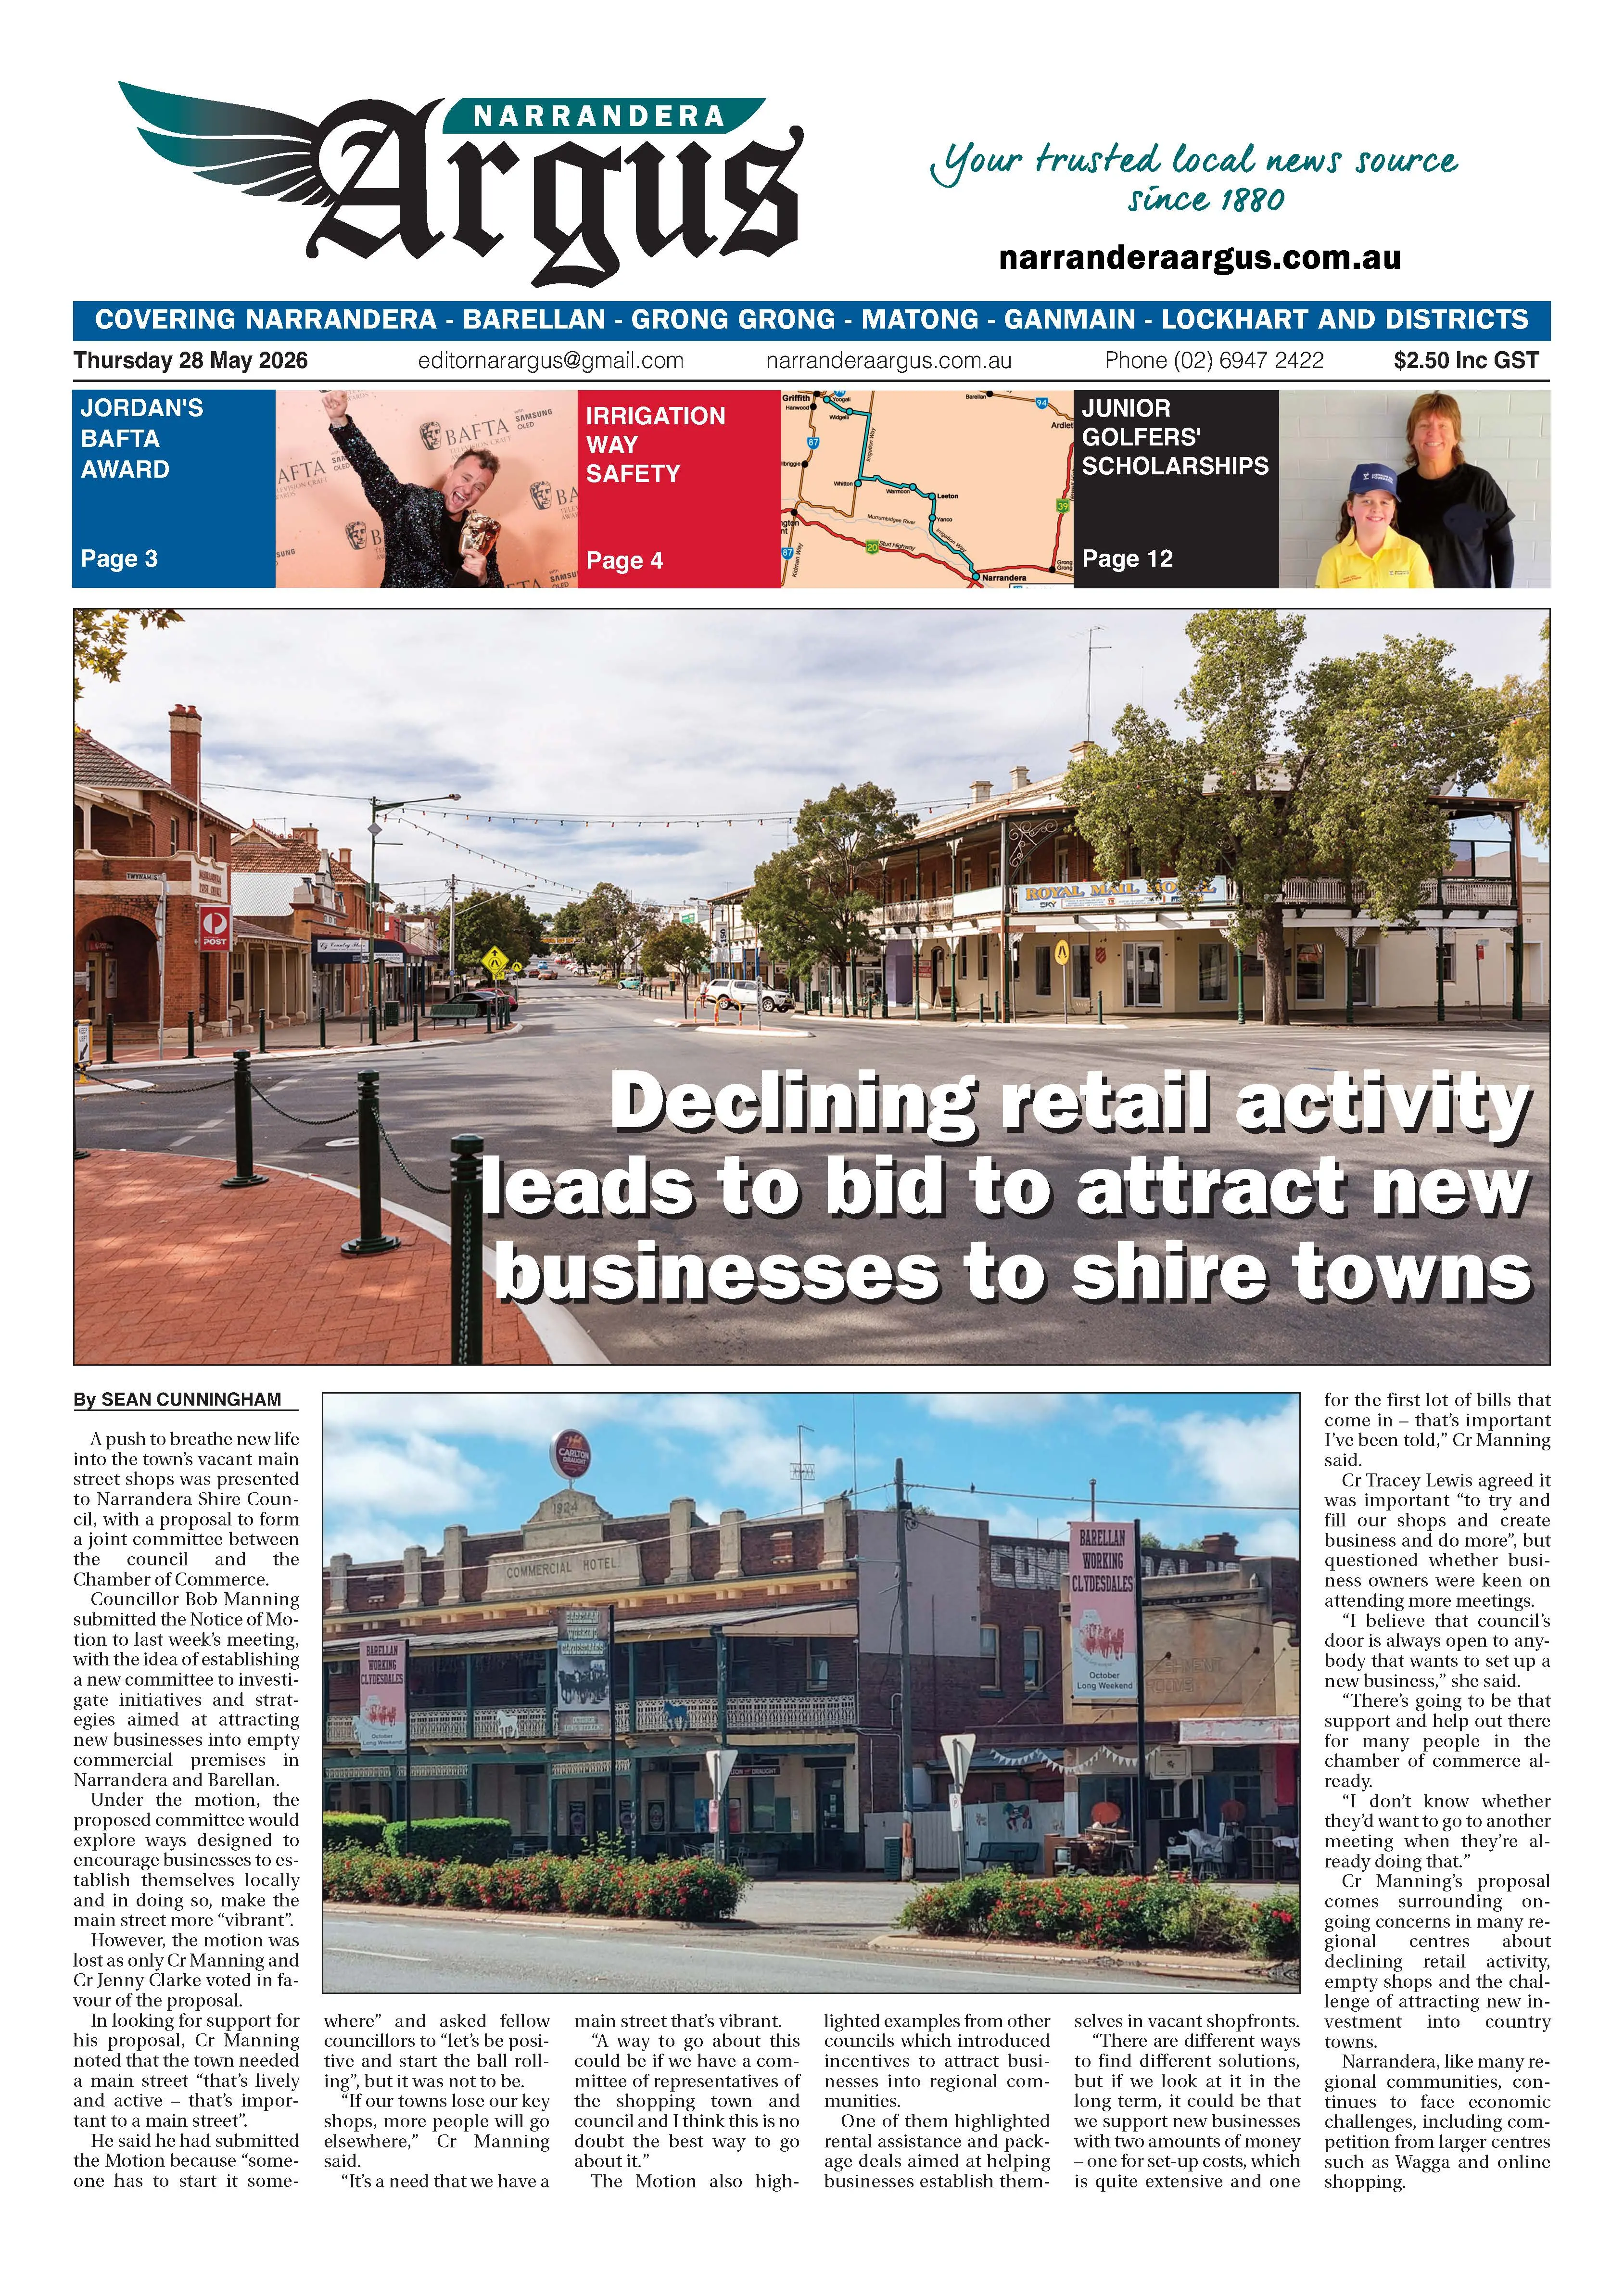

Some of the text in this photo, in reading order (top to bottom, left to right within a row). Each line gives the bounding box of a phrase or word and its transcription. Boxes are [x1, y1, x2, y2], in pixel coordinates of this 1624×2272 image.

[474, 105, 724, 127] NARRANDERA
[930, 141, 1459, 189] Your trusted local news source
[305, 98, 804, 289] Argus
[1128, 185, 1285, 213] since 1880
[1000, 244, 1400, 276] narranderaargus.com.au
[96, 309, 1528, 329] COVERING NARRANDERA BARELLAN GRONG GRONG MATONG GANMAIN LOCKHART AND DISTRICTS
[73, 351, 307, 373] Thursday 28 May 2026
[419, 351, 683, 373] editornarargus@gmail.com
[768, 351, 1011, 373] narranderaargus.com.au
[1107, 351, 1323, 372] Phone (02) 6947 2422
[1395, 350, 1539, 371] $2.50 Inc GST
[81, 398, 203, 417] JORDAN'S
[515, 409, 553, 422] SAMSUNG
[587, 406, 725, 425] IRRIGATION
[1082, 398, 1170, 418] JUNIOR
[445, 418, 510, 446] BAFTA
[517, 421, 534, 430] OLED
[82, 429, 160, 447] BAFTA
[491, 435, 512, 445] CRAFT
[586, 435, 639, 454] WAY
[1082, 427, 1201, 446] GOLFERS'
[81, 460, 169, 478] AWARD
[278, 460, 326, 484] AFTA
[333, 462, 351, 471] OLED
[586, 464, 681, 483] SAFETY
[1082, 456, 1269, 475] SCHOLARSHIPS
[276, 482, 306, 494] LEVISION
[867, 514, 902, 523] Murrumbidgee
[892, 542, 916, 552] Highway
[936, 528, 967, 553] Irrigation Way
[82, 549, 158, 572] Page 3
[276, 548, 296, 558] SUNG
[587, 551, 663, 574] Page 4
[1083, 549, 1173, 572] Page 12
[550, 571, 578, 583] SAMSU
[1025, 886, 1085, 901] ROYAL
[1091, 883, 1140, 896] MAIL
[1040, 900, 1057, 908] SKY
[612, 1069, 1531, 1144] Declining retail activity
[483, 1155, 1531, 1216] leads to bid to attract new
[496, 1240, 1532, 1301] businesses to shire towns
[74, 1392, 281, 1409] By SEAN CUNNINGHAM
[558, 1447, 589, 1460] CARLTON
[563, 1456, 587, 1464] DRAUGHT
[1343, 1473, 1551, 1491] Cr Tracey Lewis agreed it
[1080, 1529, 1125, 1547] BARELLAN
[507, 1562, 572, 1579] COMMERCIAL
[1083, 1552, 1124, 1570] WORKING
[1072, 1575, 1133, 1592] CLYDESDALES
[367, 1645, 398, 1656] BARELLAN
[368, 1660, 397, 1671] WORKING
[361, 1674, 403, 1685] CLYDESDALES
[1078, 1682, 1097, 1690] Long
[842, 2114, 1050, 2132] One of them highlighted
